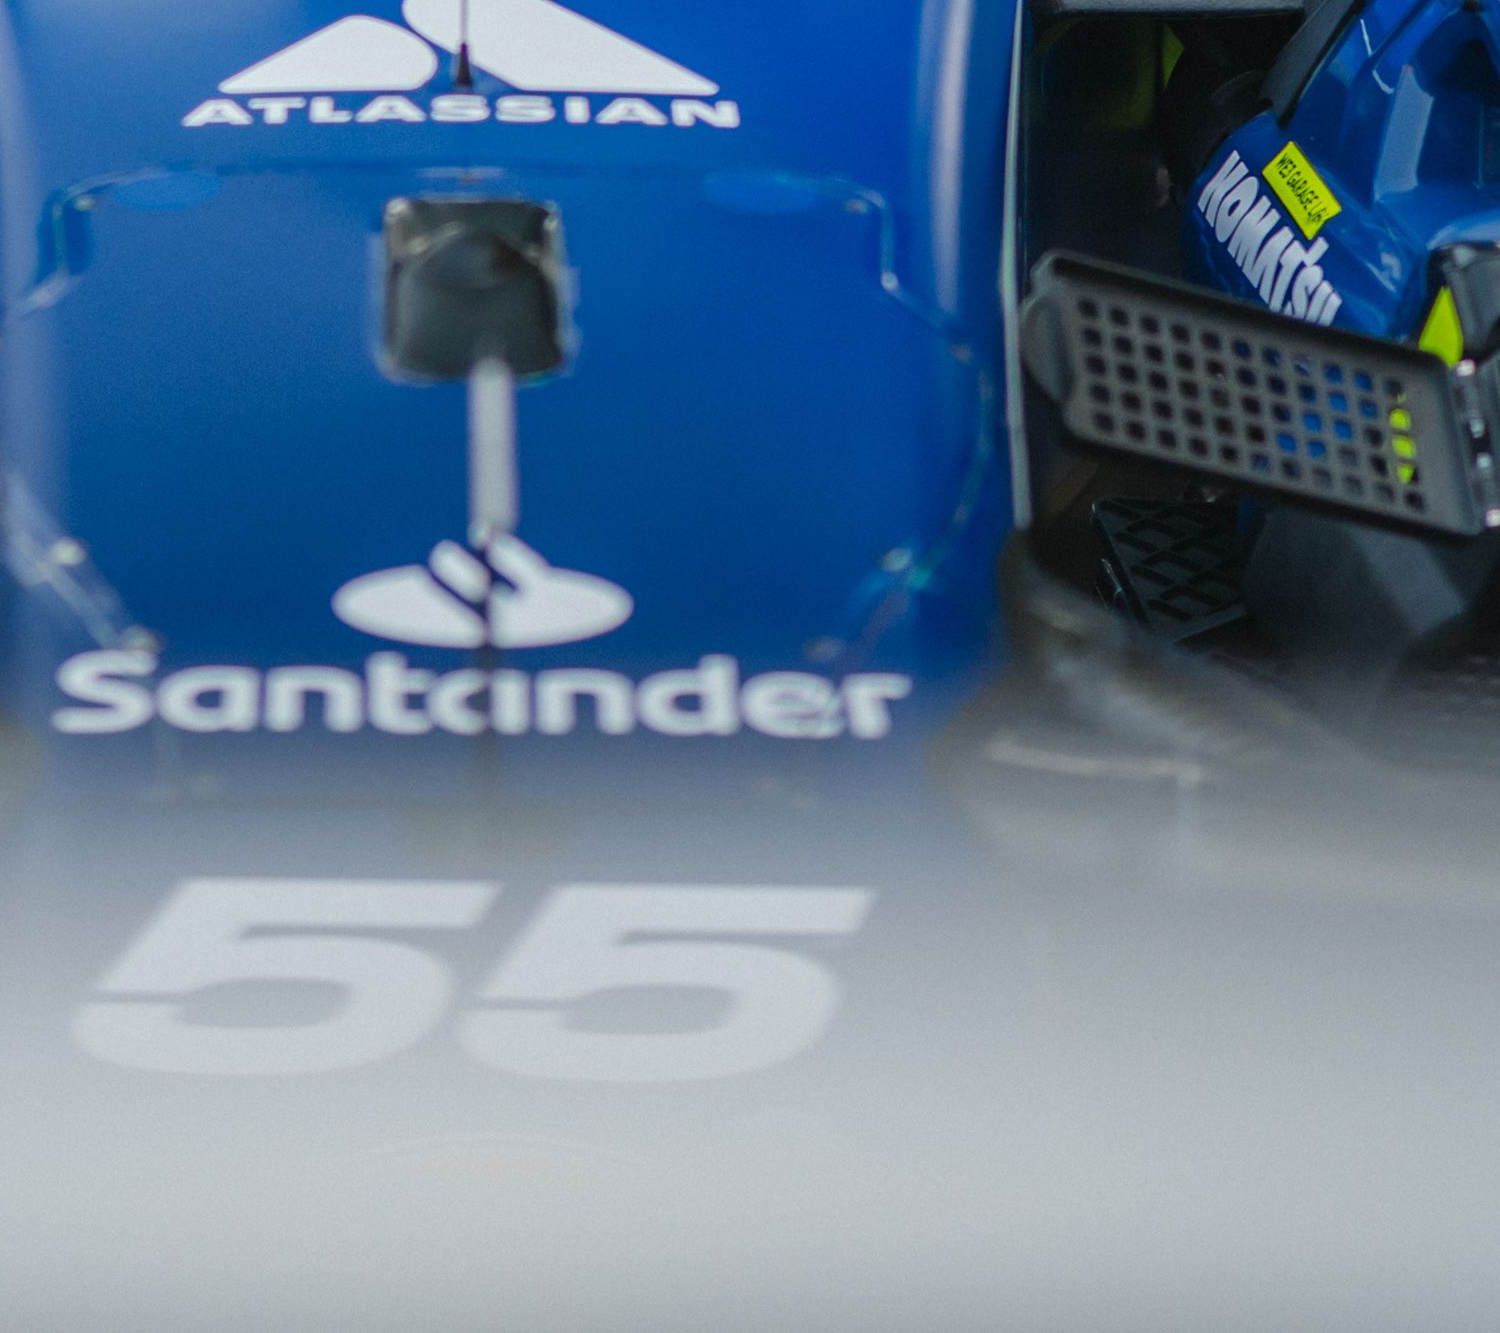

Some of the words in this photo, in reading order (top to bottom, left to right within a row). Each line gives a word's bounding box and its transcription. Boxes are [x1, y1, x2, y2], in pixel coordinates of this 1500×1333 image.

[182, 94, 740, 127] ATLASSIAN
[52, 650, 913, 738] Santander
[70, 877, 877, 1083] 55
